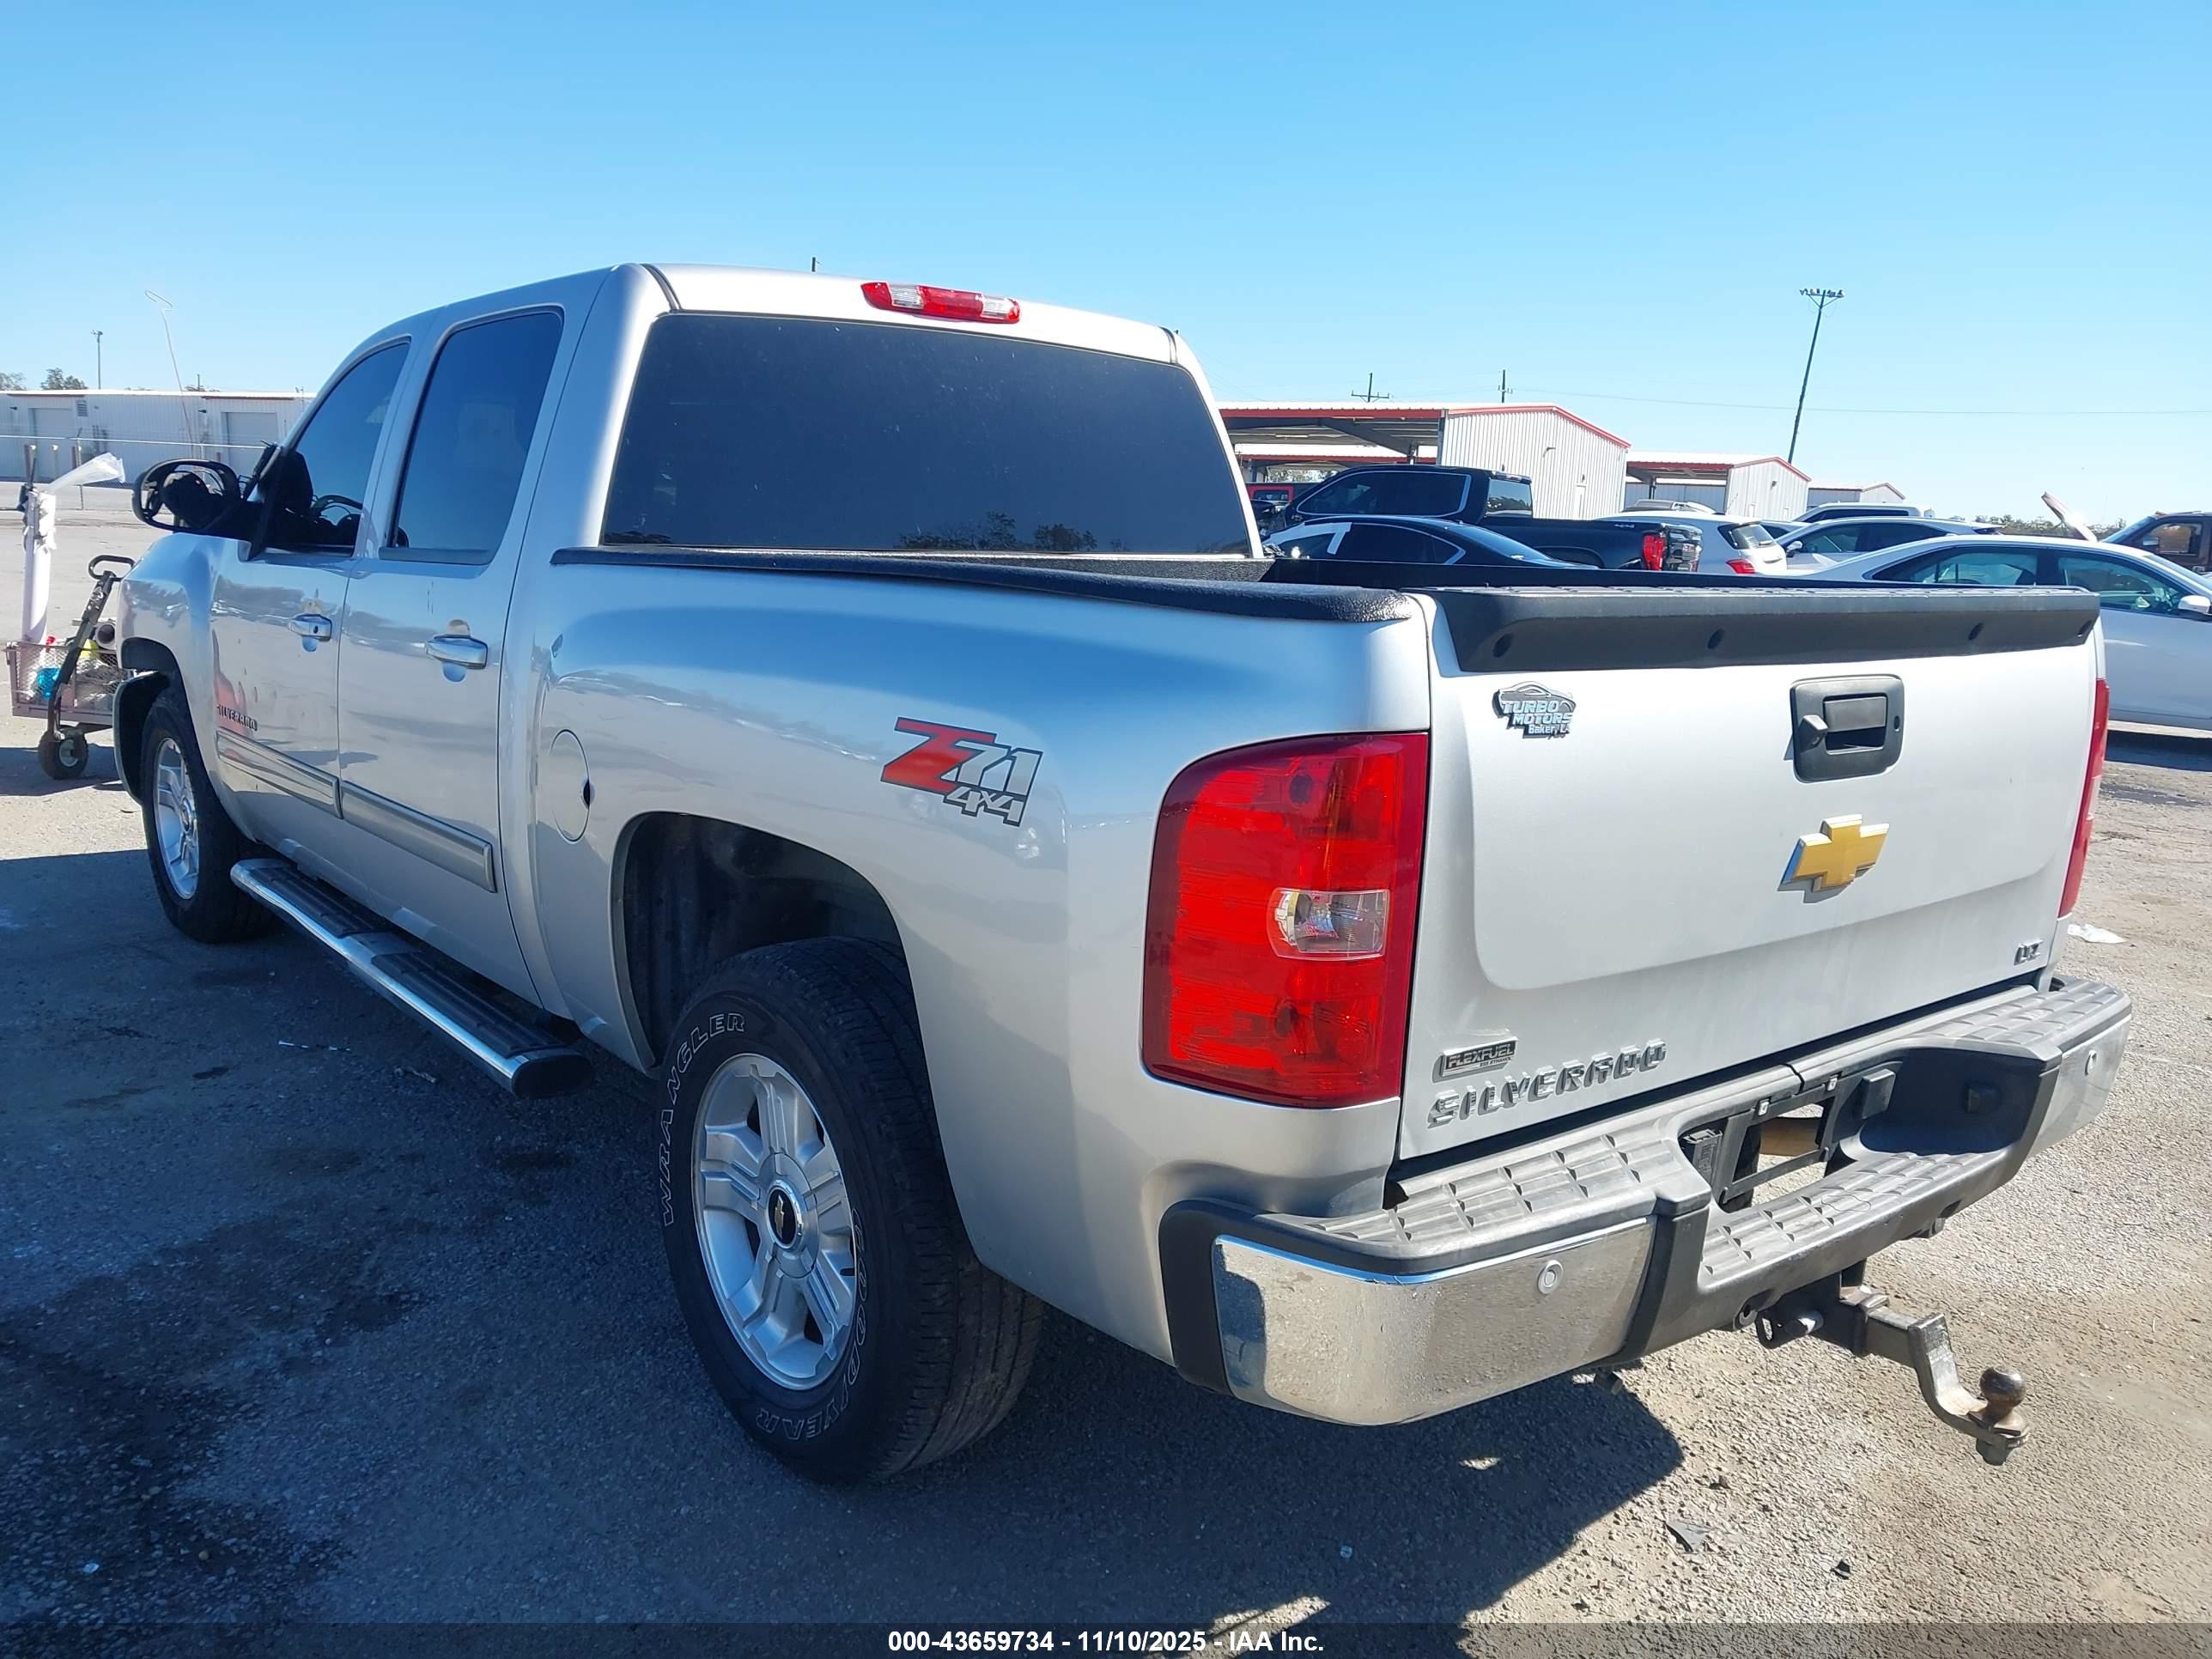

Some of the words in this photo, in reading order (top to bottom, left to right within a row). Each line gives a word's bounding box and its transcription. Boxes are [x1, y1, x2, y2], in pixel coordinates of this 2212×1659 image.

[1501, 700, 1559, 714] TURBO
[1511, 712, 1574, 726] MOTORS
[880, 716, 1043, 797] Z71
[1447, 1042, 1514, 1069] FLEXFUEL
[1429, 1039, 1668, 1127] SILVERADO
[659, 1012, 745, 1227] WRANGLER
